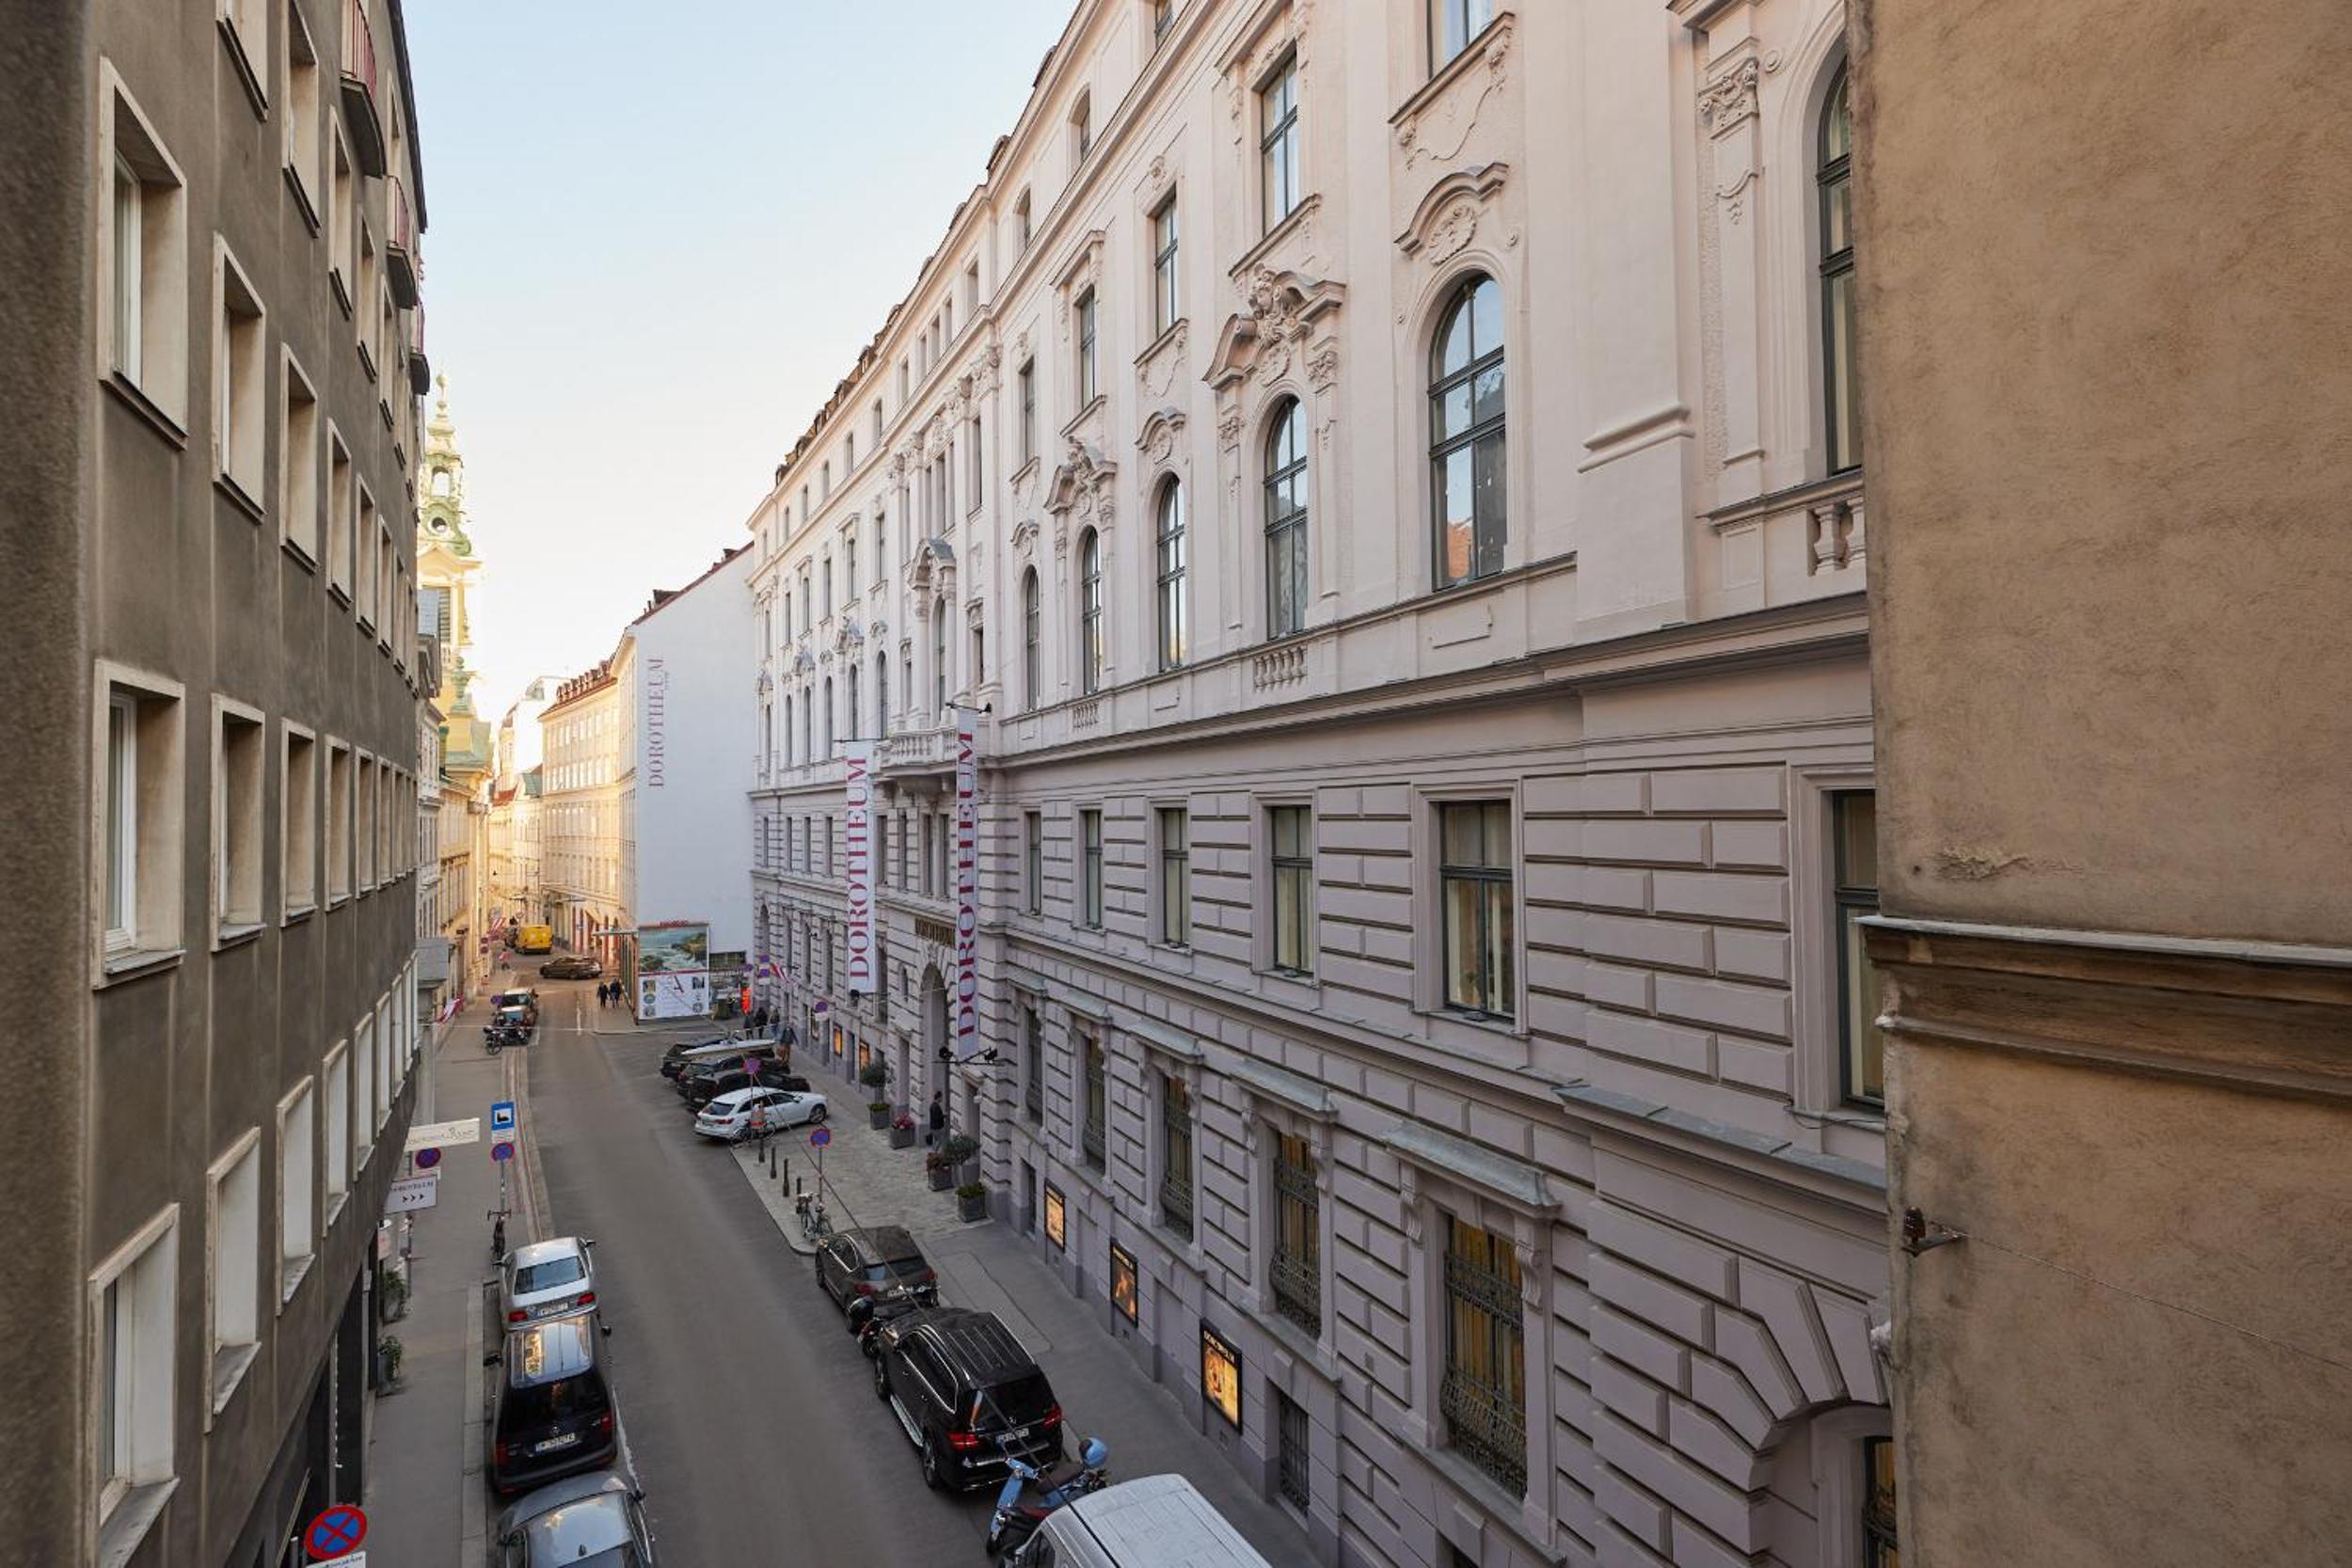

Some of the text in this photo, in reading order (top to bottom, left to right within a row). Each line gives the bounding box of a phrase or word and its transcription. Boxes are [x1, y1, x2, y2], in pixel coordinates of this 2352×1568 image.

[646, 657, 665, 788] DOROTHEUM
[847, 758, 869, 979] DOROTHEUM
[957, 732, 975, 1035] DOROTHEUM
